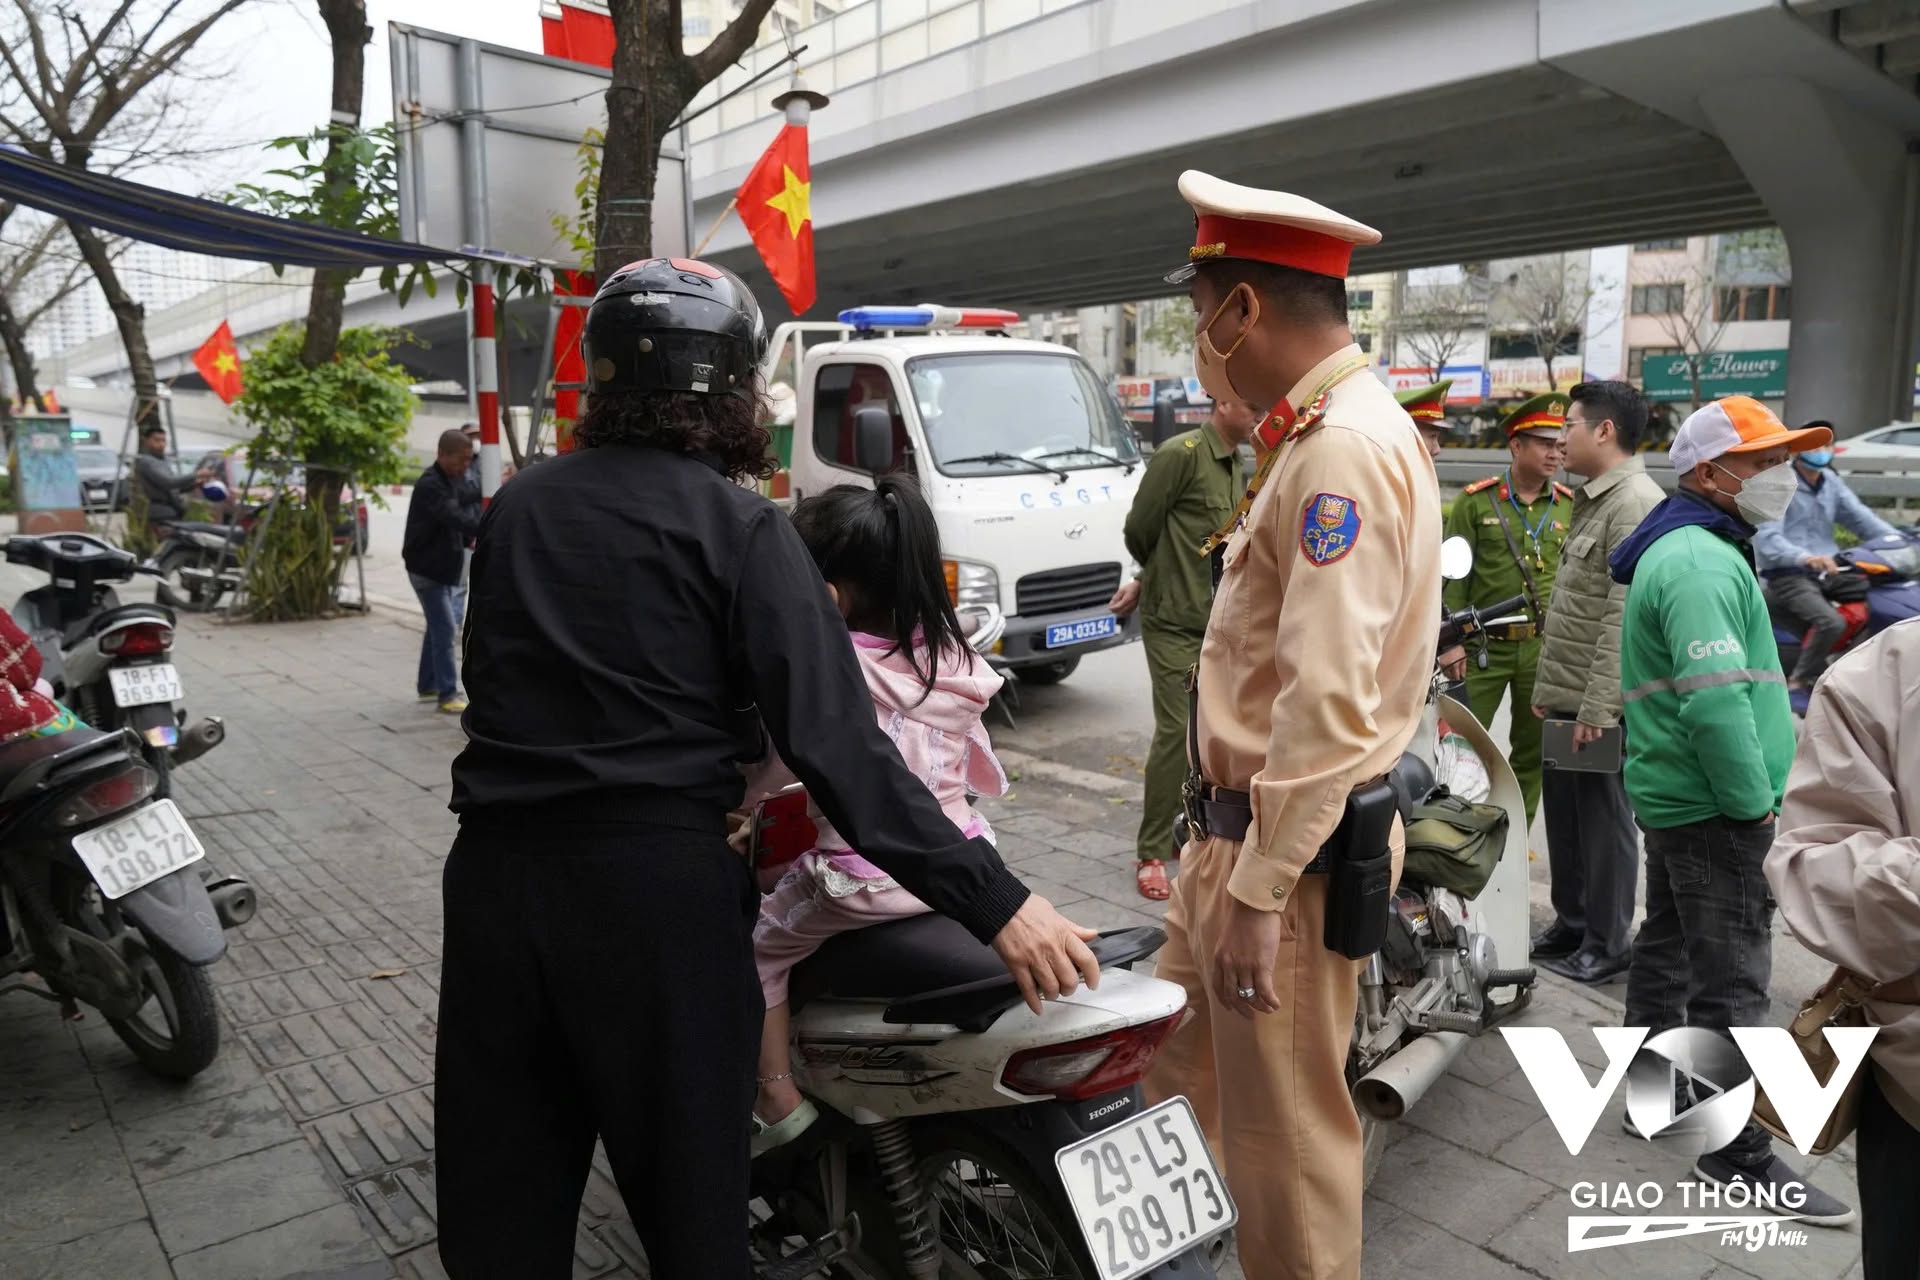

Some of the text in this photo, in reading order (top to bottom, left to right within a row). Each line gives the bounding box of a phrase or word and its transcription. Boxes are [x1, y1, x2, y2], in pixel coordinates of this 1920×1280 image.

[1709, 353, 1779, 374] Flower
[1053, 620, 1110, 643] 29A-033.54
[1688, 633, 1740, 660] Grab
[121, 667, 169, 686] 18-F1
[120, 682, 178, 703] 369.97
[93, 809, 169, 859] 18-L1
[102, 832, 197, 891] 198.72
[1088, 1096, 1131, 1121] HONDA
[1080, 1114, 1188, 1207] 29-L5
[1094, 1168, 1224, 1277] 289.73
